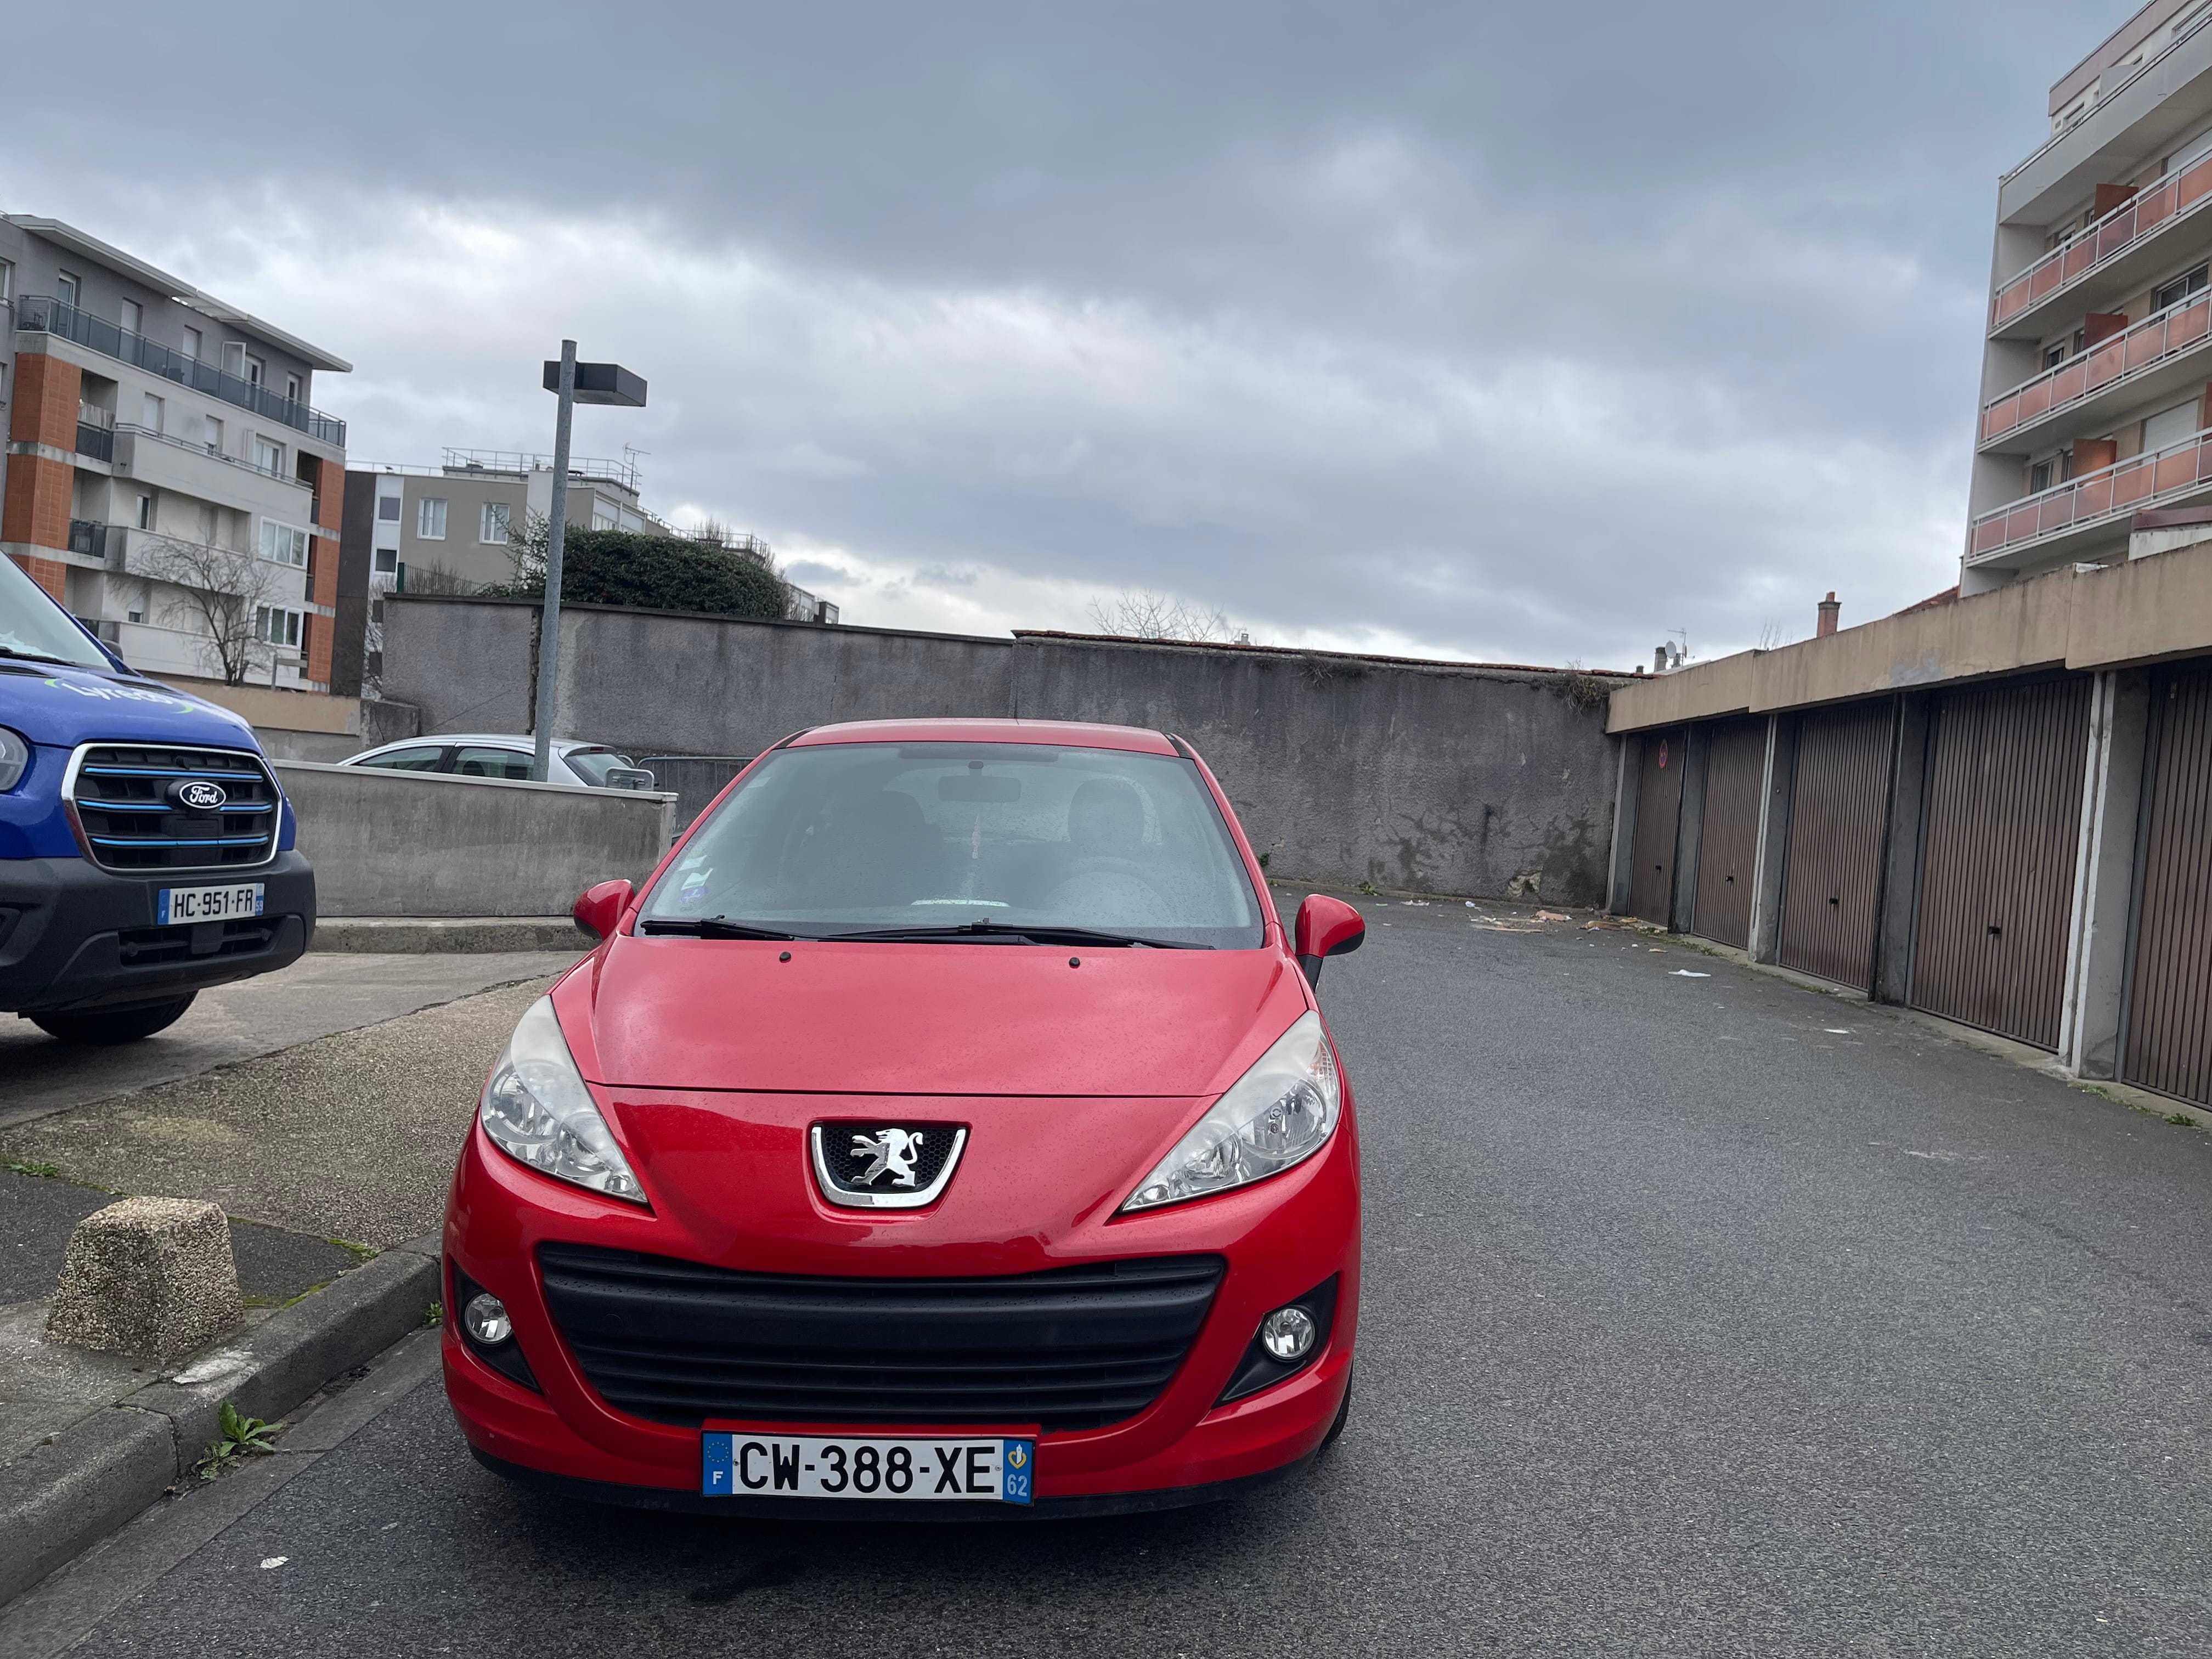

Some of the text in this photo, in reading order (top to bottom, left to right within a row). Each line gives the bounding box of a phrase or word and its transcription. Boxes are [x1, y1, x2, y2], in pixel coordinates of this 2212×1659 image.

[190, 786, 217, 804] Ford
[255, 900, 263, 912] 59
[713, 1442, 1028, 1497] F CW-388-XE 62
